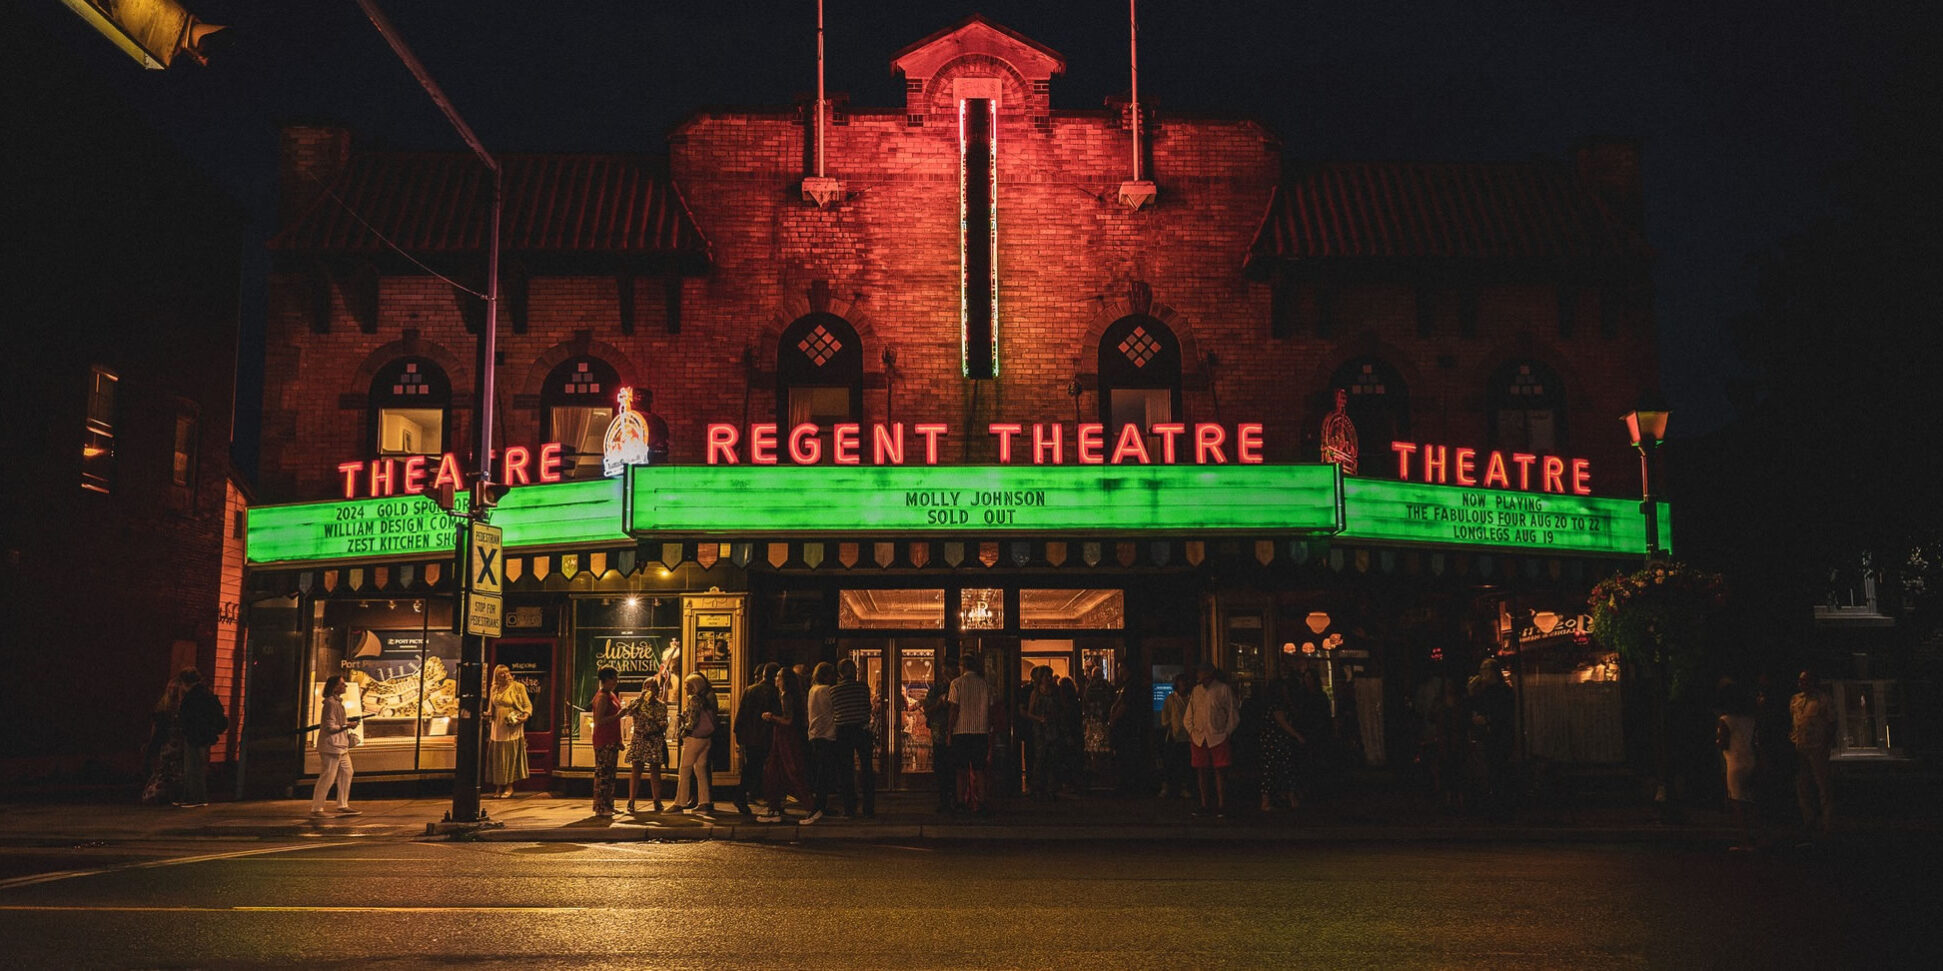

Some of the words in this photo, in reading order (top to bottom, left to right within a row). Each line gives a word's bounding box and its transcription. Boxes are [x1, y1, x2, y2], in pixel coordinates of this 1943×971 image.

[706, 422, 949, 465] REGENT
[989, 422, 1265, 465] THEATRE
[338, 442, 561, 498] THEARE
[1391, 441, 1592, 495] THEATRE
[905, 491, 961, 507] MOLLY
[970, 491, 1046, 507] JOHNSON
[1462, 492, 1486, 508] NOW
[1496, 495, 1543, 512] PLAYING
[336, 506, 365, 521] 2024
[377, 502, 409, 518] GOLD
[927, 509, 969, 525] SOLD
[984, 509, 1016, 525] OUT
[1406, 505, 1428, 520] THE
[1434, 506, 1494, 524] FABULOUS
[1499, 510, 1526, 527] FOUR
[1530, 513, 1551, 528] AUG
[1555, 515, 1568, 529] 20
[1571, 517, 1585, 531] TO
[1589, 518, 1600, 532] 22
[324, 522, 375, 538] WILLIAM
[380, 517, 424, 534] DESIGN
[1453, 525, 1510, 542] LONGLEGS
[1515, 528, 1537, 543] AUG
[1543, 530, 1554, 544] 19
[348, 537, 375, 553] ZEST
[380, 534, 430, 550] KITCHEN
[476, 531, 500, 545] PEDESTRIAN
[475, 601, 486, 613] STOP
[487, 603, 497, 615] FOR
[470, 615, 500, 629] PEDESTRIANS
[596, 639, 655, 660] lustre
